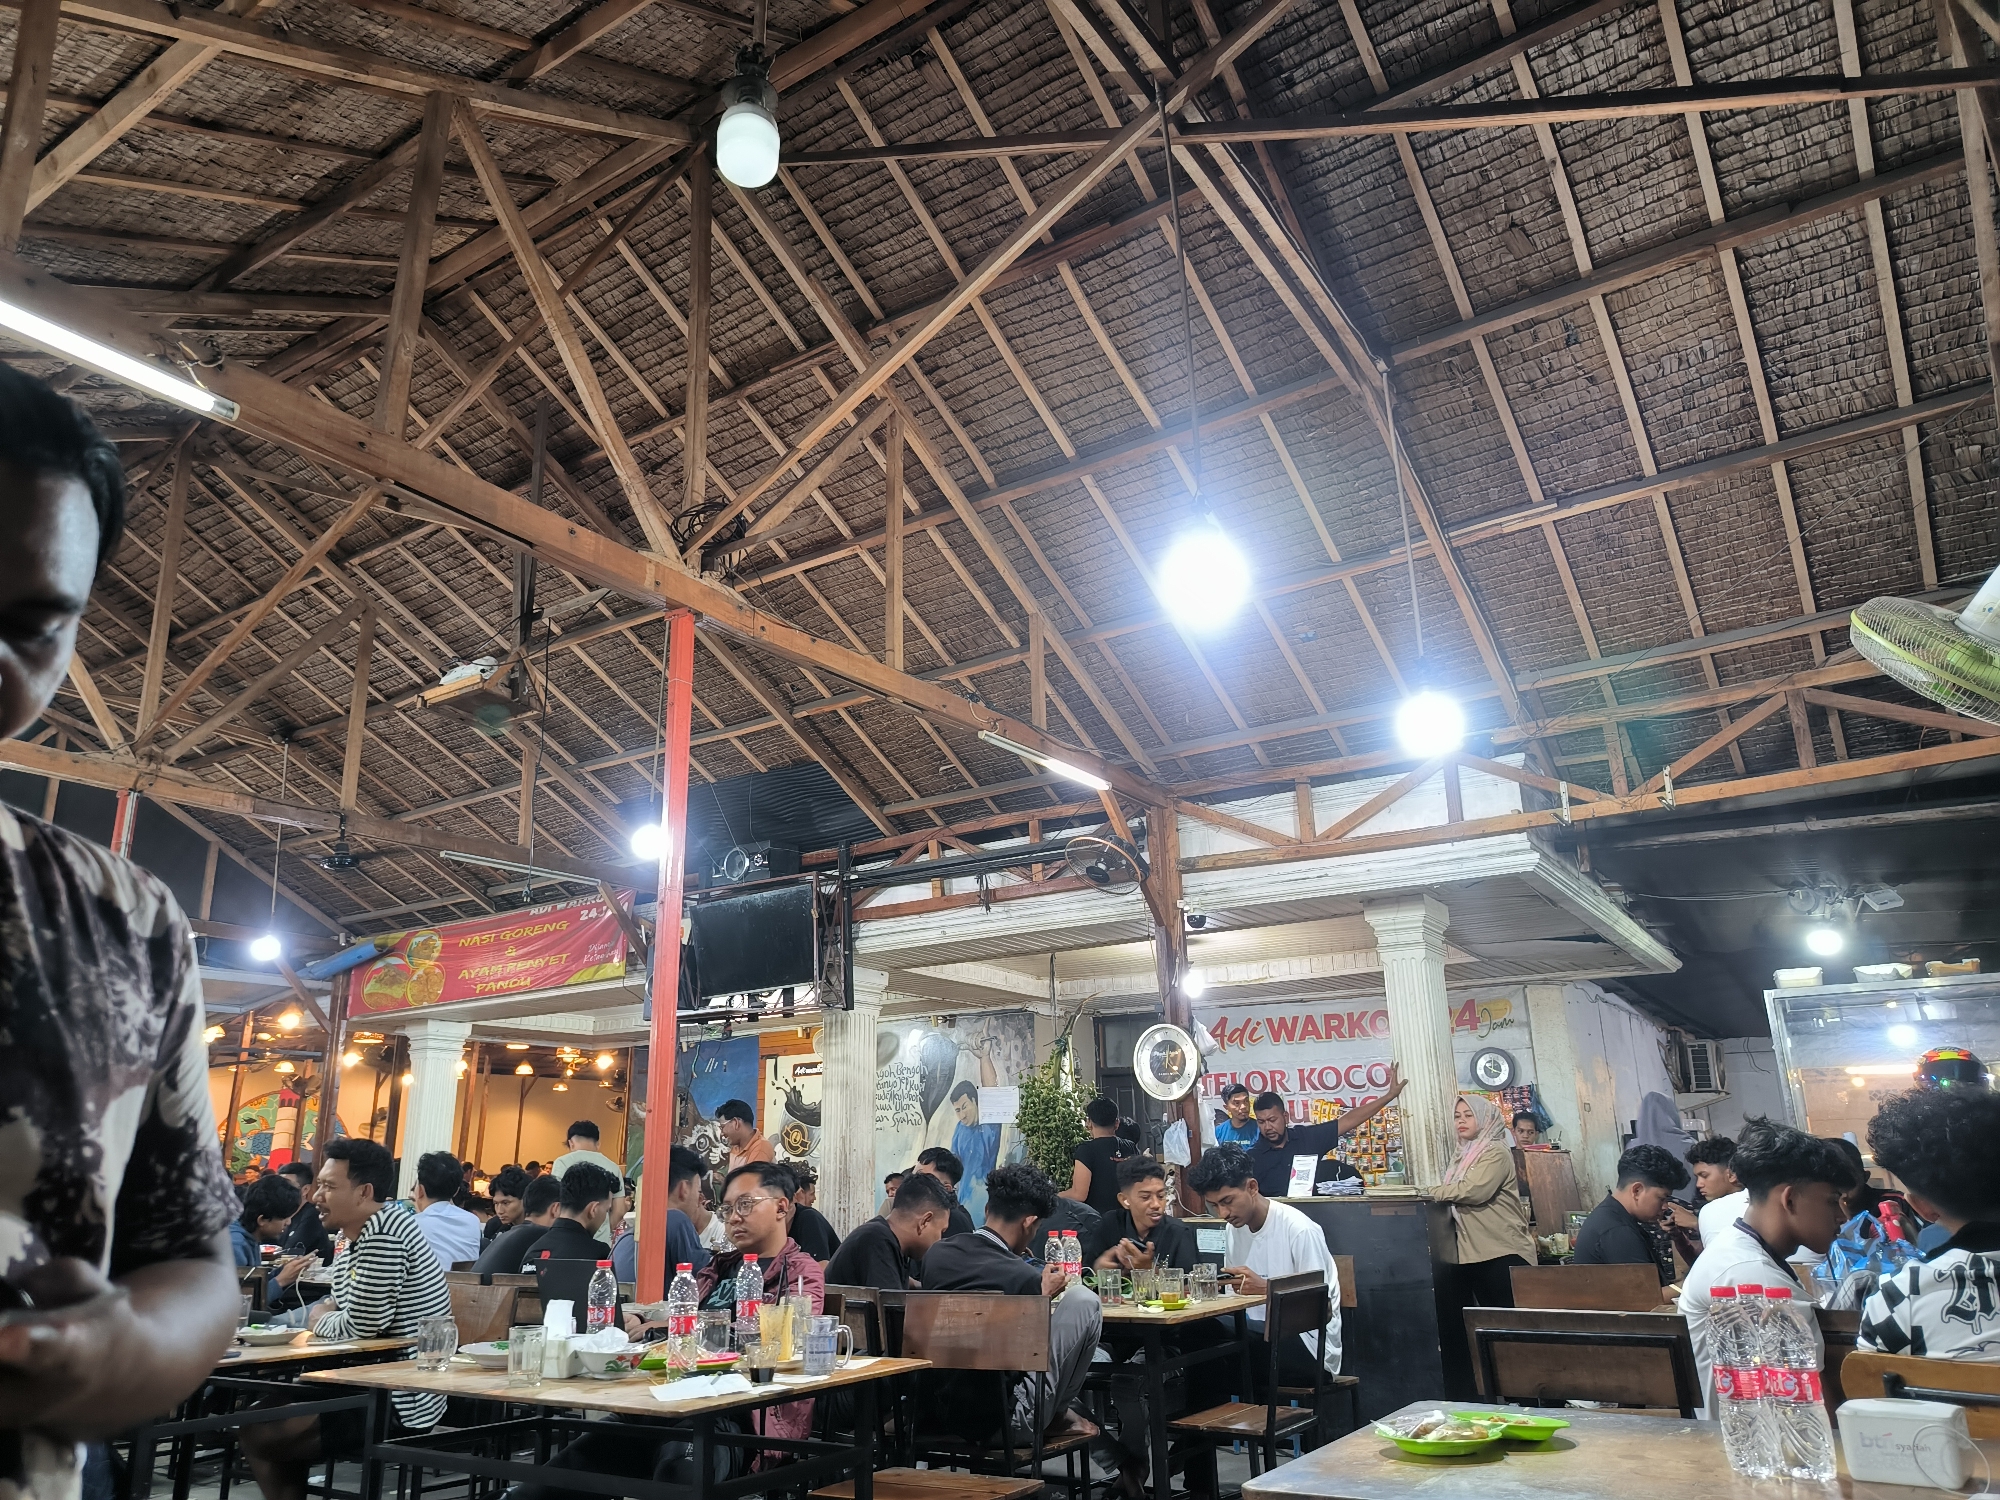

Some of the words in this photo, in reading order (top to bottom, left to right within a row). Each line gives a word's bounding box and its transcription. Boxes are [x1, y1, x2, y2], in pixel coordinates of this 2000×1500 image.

[458, 933, 495, 947] NASI
[500, 920, 571, 941] GORENG
[458, 964, 503, 980] AYAM
[506, 952, 572, 973] PENYET
[1210, 1015, 1265, 1051] Adi
[1266, 1009, 1390, 1043] WARKO
[1448, 998, 1481, 1034] 4
[1478, 1007, 1515, 1038] Jam
[1200, 1069, 1292, 1097] TELOR
[1297, 1062, 1391, 1093] KOCO
